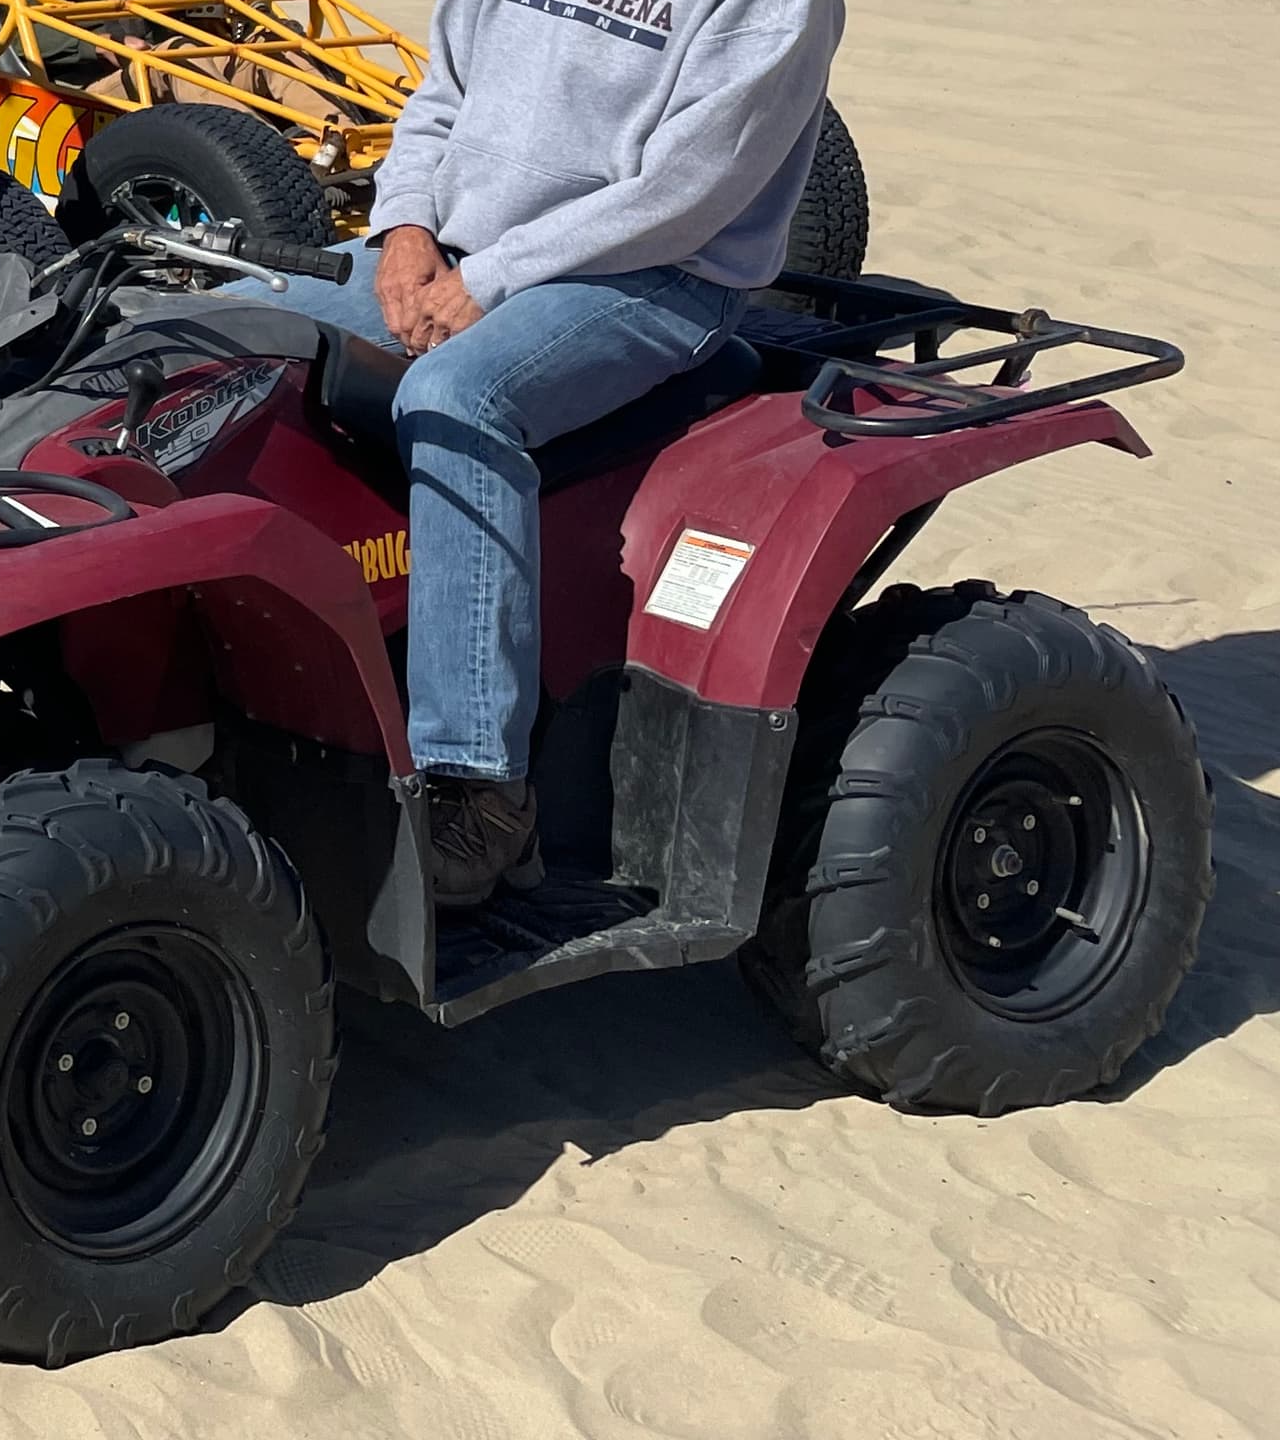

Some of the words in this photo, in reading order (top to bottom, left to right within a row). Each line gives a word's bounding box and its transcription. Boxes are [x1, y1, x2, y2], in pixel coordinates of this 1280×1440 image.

[86, 367, 128, 392] YAM
[136, 362, 272, 448] KODIAK
[154, 422, 210, 458] 450
